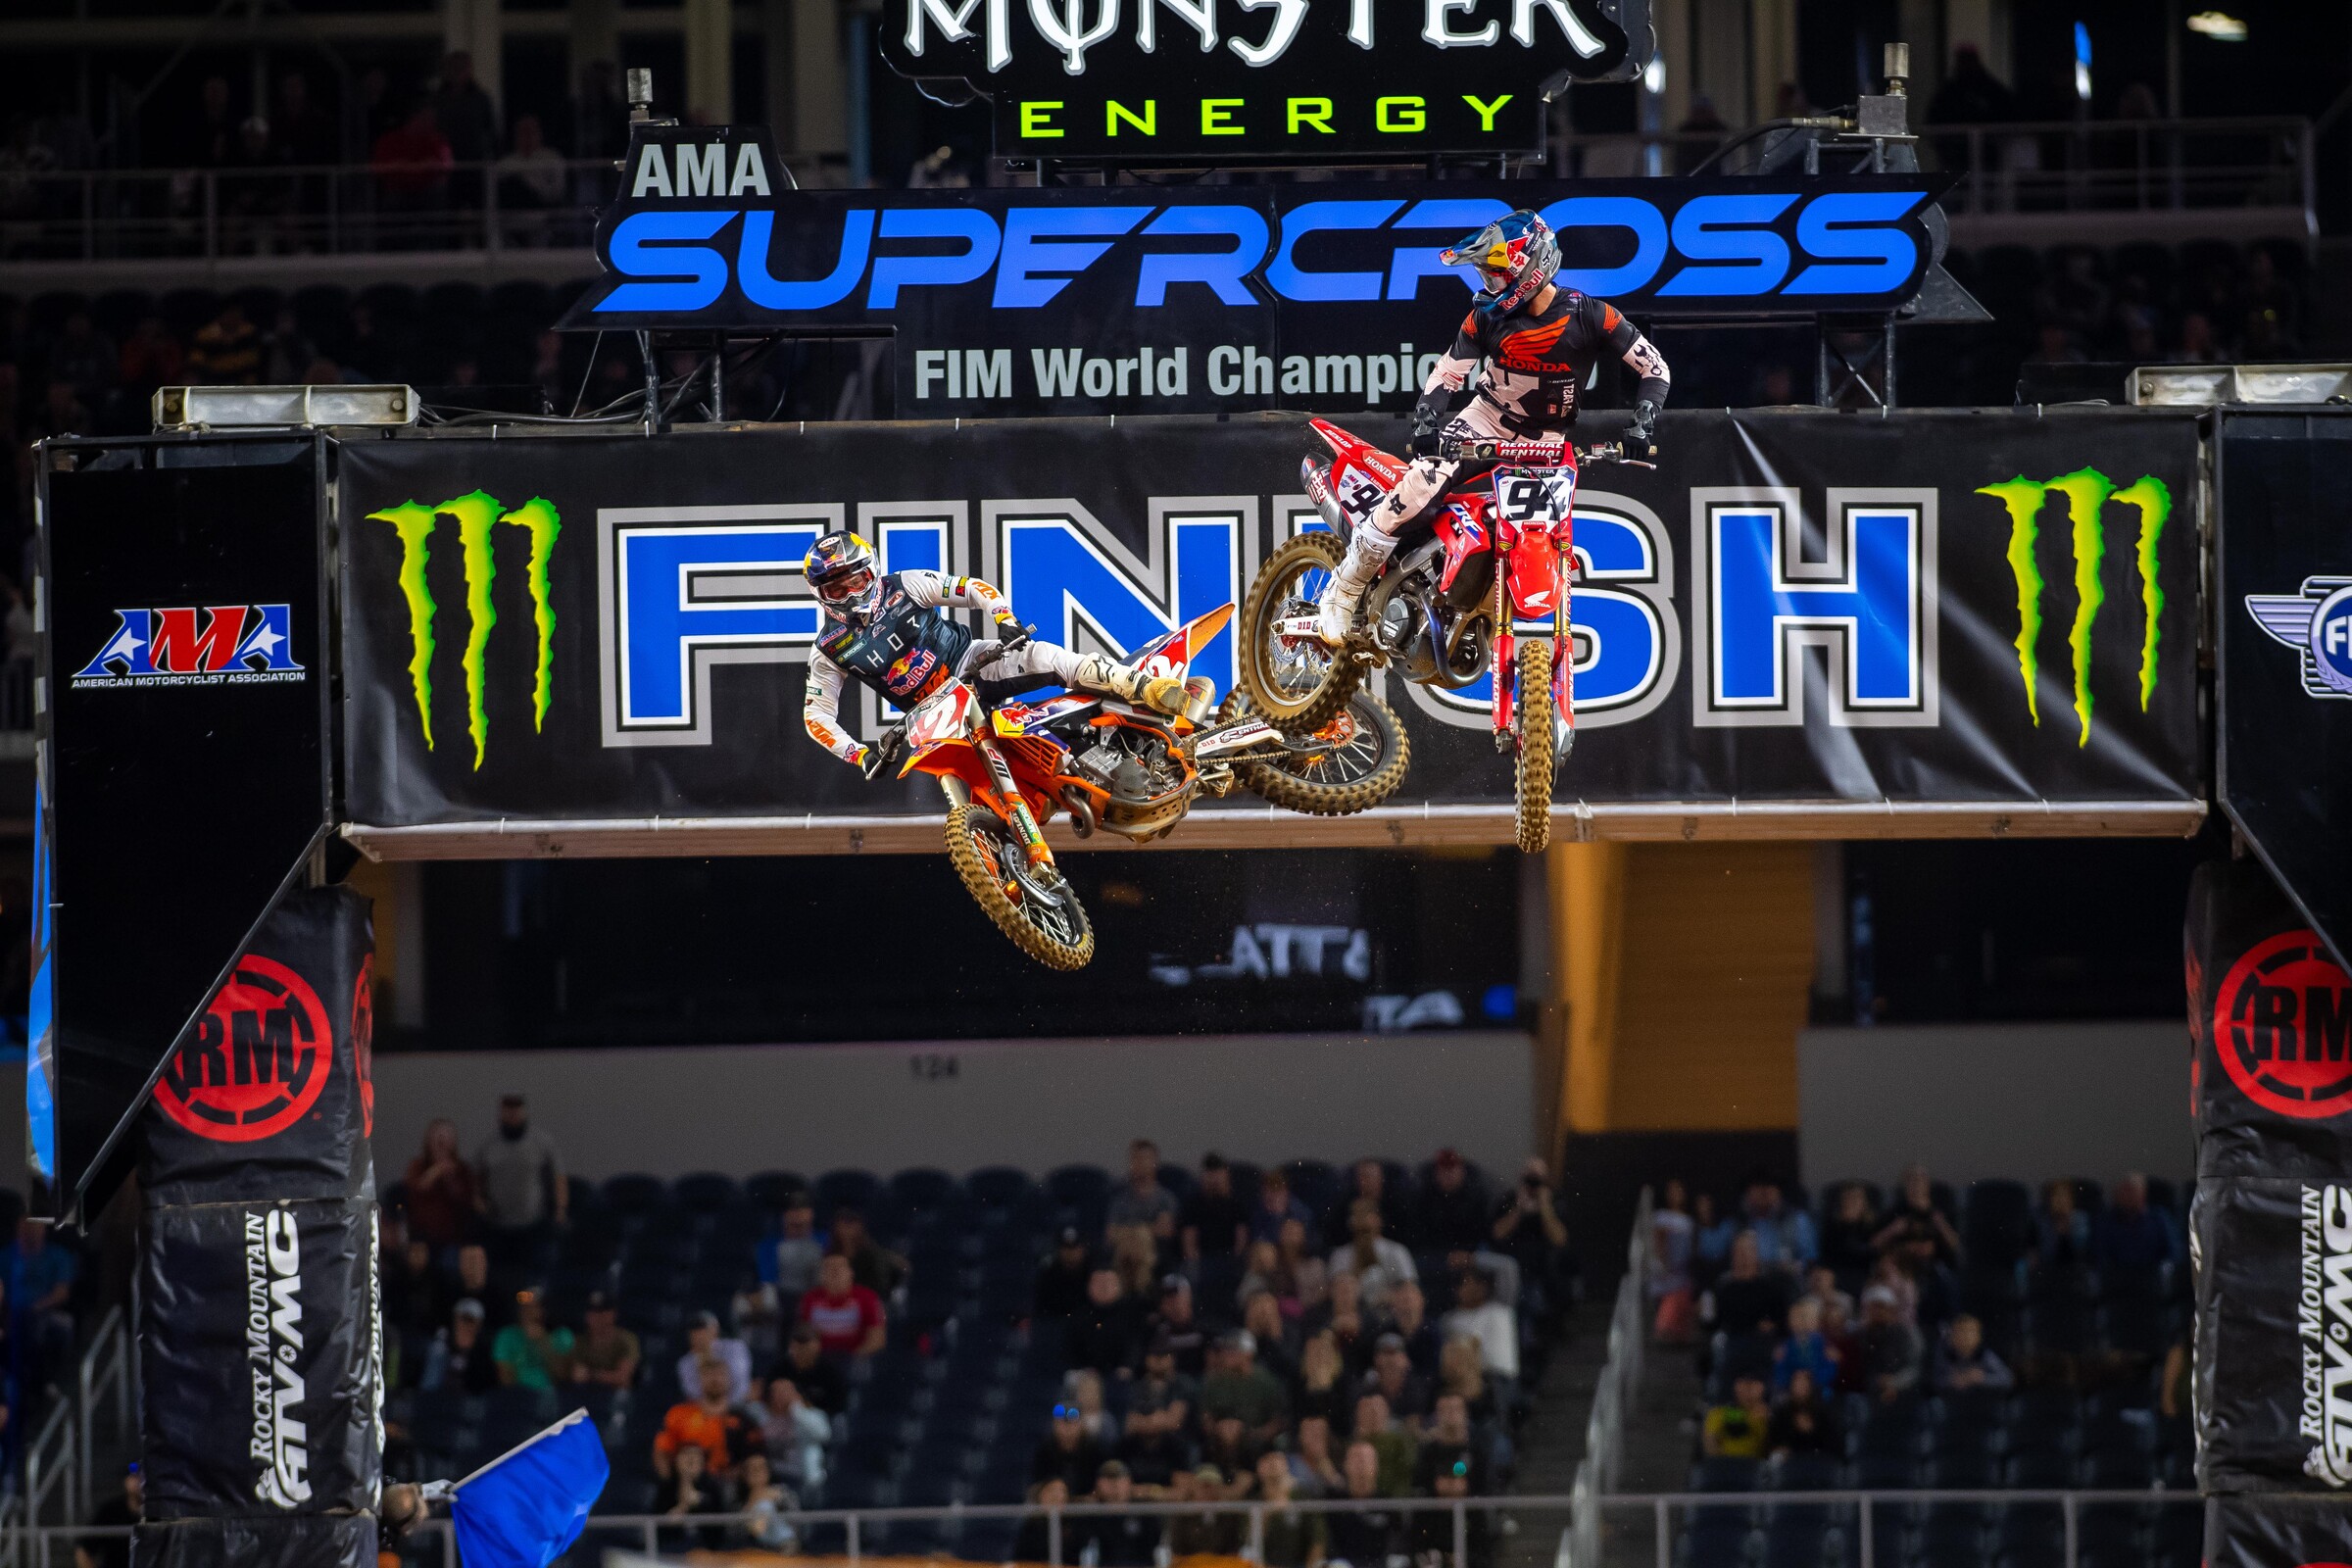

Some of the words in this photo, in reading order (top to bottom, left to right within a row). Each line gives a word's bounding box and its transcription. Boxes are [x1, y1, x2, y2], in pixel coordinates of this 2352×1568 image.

[1020, 94, 1514, 137] ENERGY
[631, 142, 772, 197] AMA
[591, 191, 1929, 312] SUPERCROSS
[915, 348, 1013, 399] FIM
[1031, 345, 1190, 398] World
[1498, 356, 1572, 372] HONDA
[1364, 456, 1396, 482] HONDA
[1505, 480, 1567, 521] 94
[72, 604, 306, 678] AMA
[72, 677, 133, 690] AMERICAN
[135, 674, 225, 687] MOTORCYCLIST
[227, 671, 306, 684] ASSOCIATION
[890, 674, 919, 697] Red
[910, 649, 937, 681] Bull
[193, 1008, 296, 1087] RM
[245, 1210, 271, 1366] MOUNTAIN
[2298, 1183, 2324, 1343] MOUNTAIN
[250, 1366, 274, 1463] ROCKY
[2300, 1343, 2324, 1442] ROCKY
